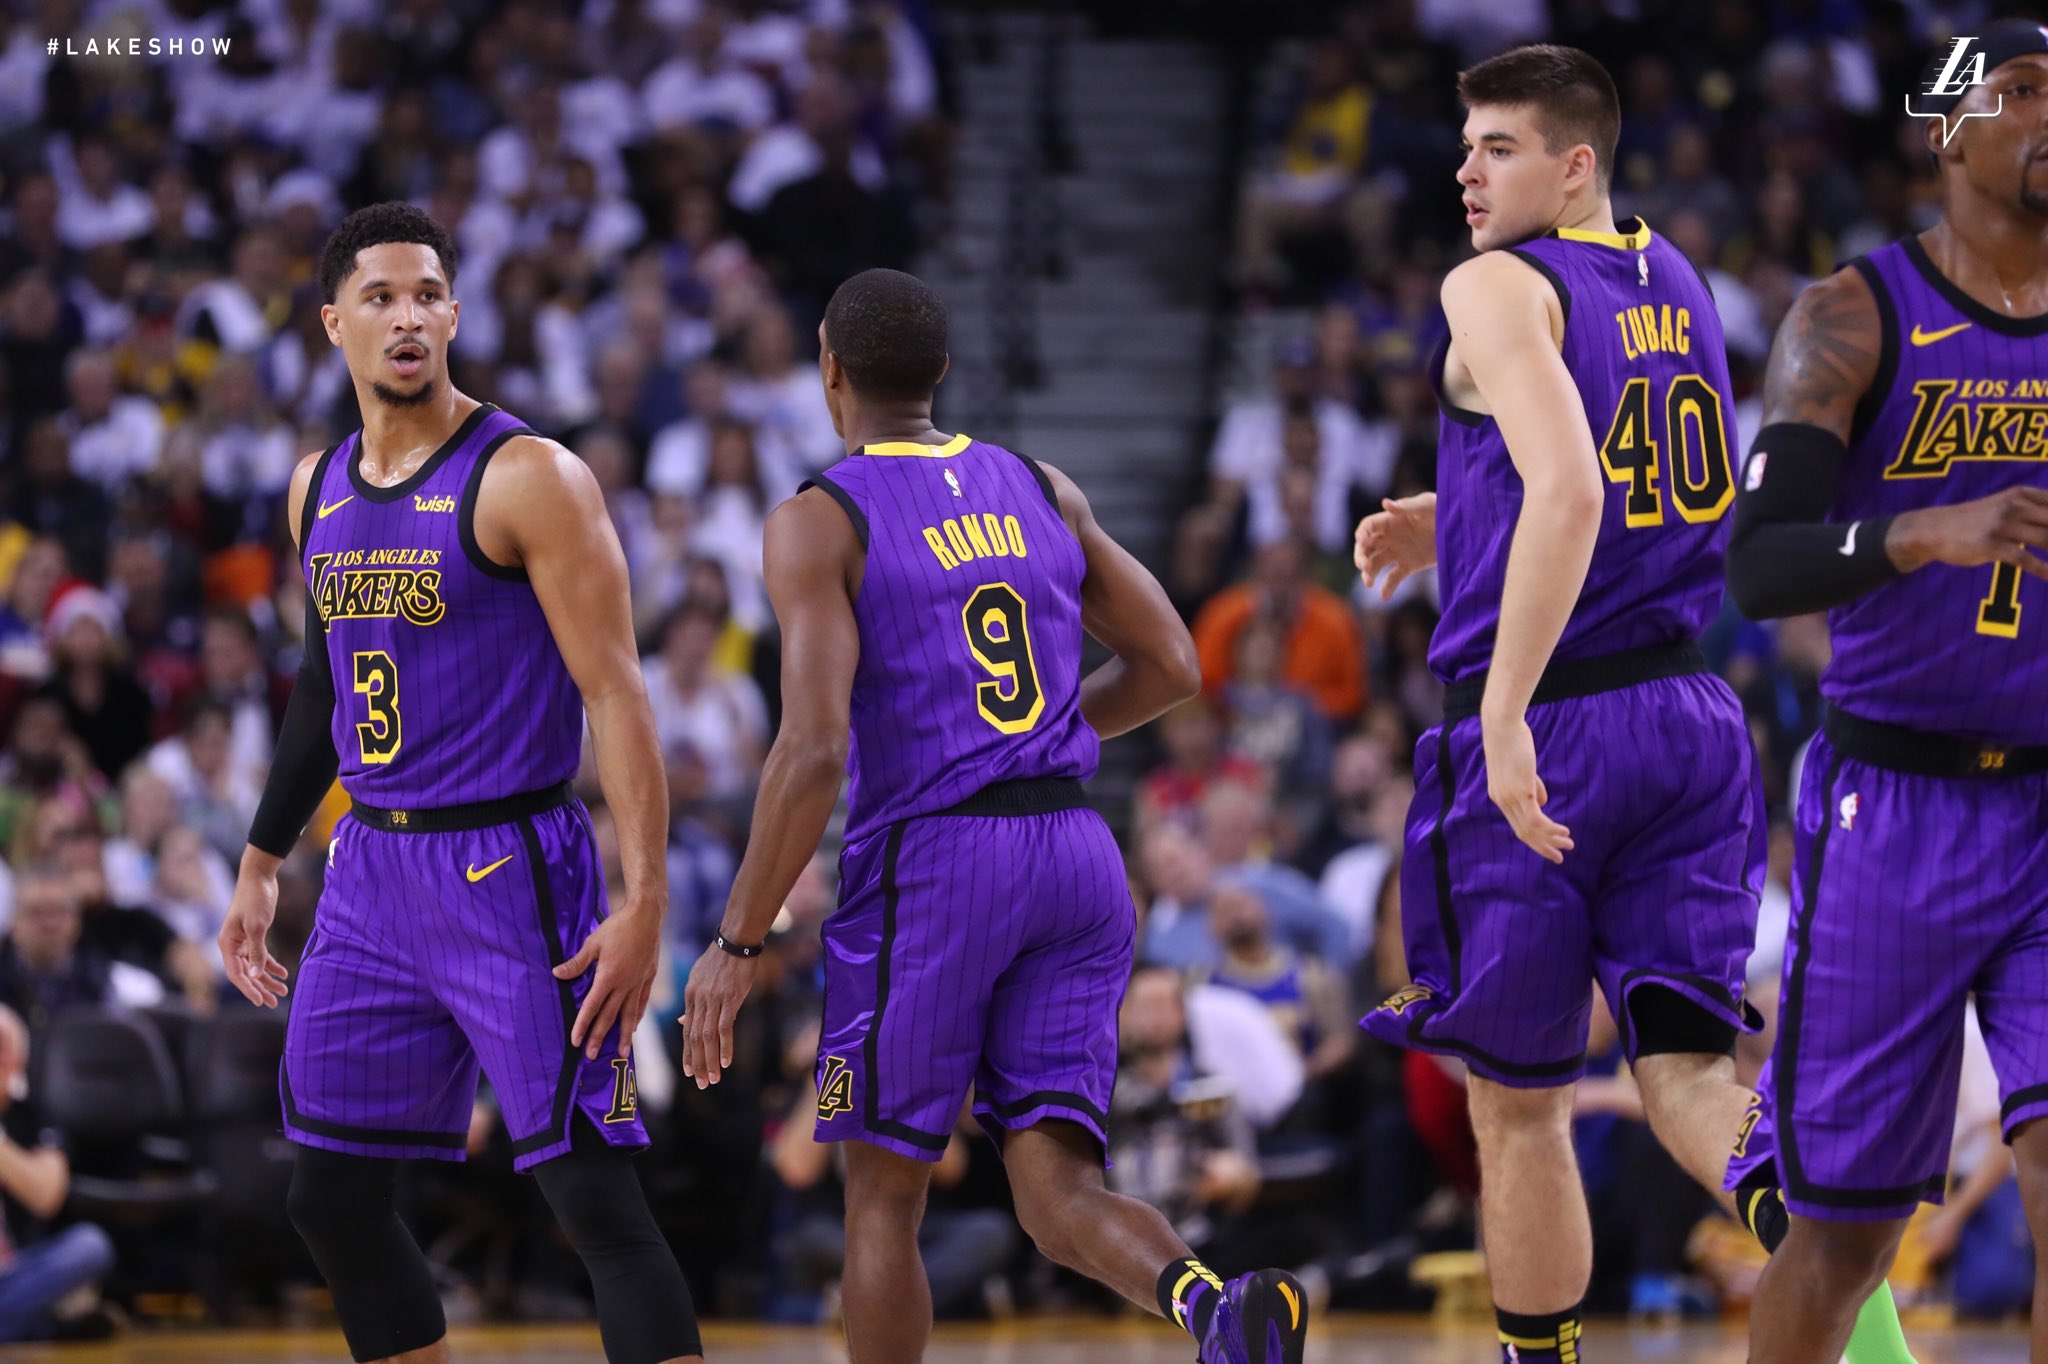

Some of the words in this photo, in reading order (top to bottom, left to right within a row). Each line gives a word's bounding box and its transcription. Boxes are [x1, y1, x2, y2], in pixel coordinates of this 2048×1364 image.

[1615, 303, 1691, 361] ZUBAC
[1958, 379, 2009, 399] LOS
[1599, 373, 1737, 529] 40
[413, 494, 456, 513] wish
[332, 549, 365, 568] LOS
[365, 549, 443, 566] ANGELES
[921, 512, 1028, 571] RONDO
[309, 552, 446, 633] LAKERS
[961, 581, 1046, 735] 9
[353, 650, 402, 764] 3
[603, 1058, 638, 1124] LA
[818, 1055, 854, 1121] LA
